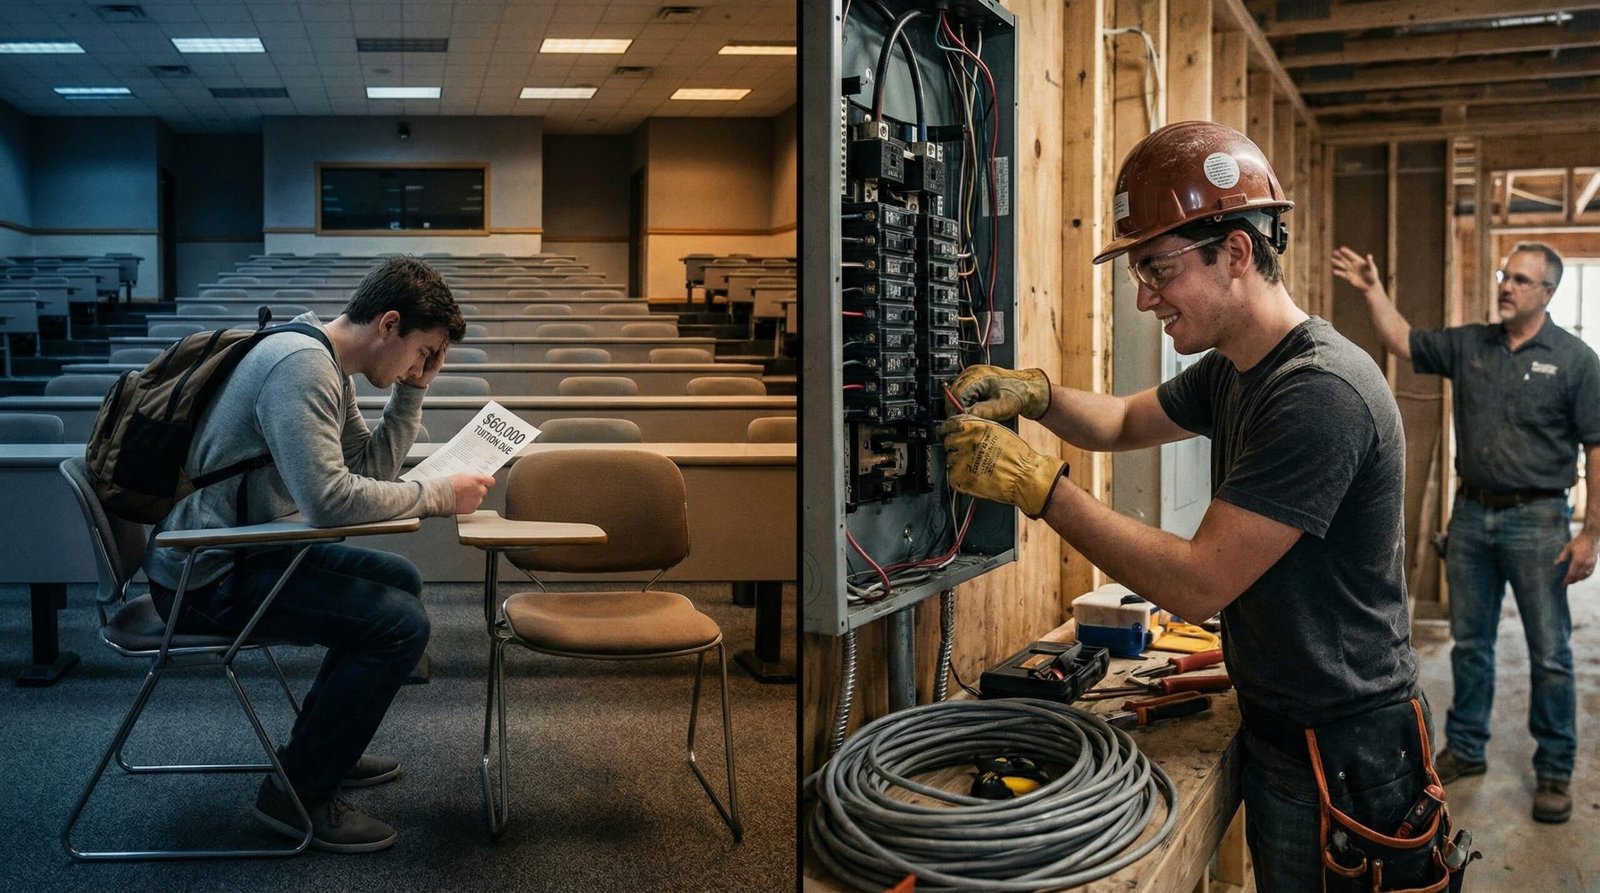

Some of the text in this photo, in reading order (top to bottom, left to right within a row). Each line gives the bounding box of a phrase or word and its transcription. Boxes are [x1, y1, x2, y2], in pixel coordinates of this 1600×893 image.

[474, 425, 513, 455] TUITION DUE
[483, 413, 525, 445] $60,000
